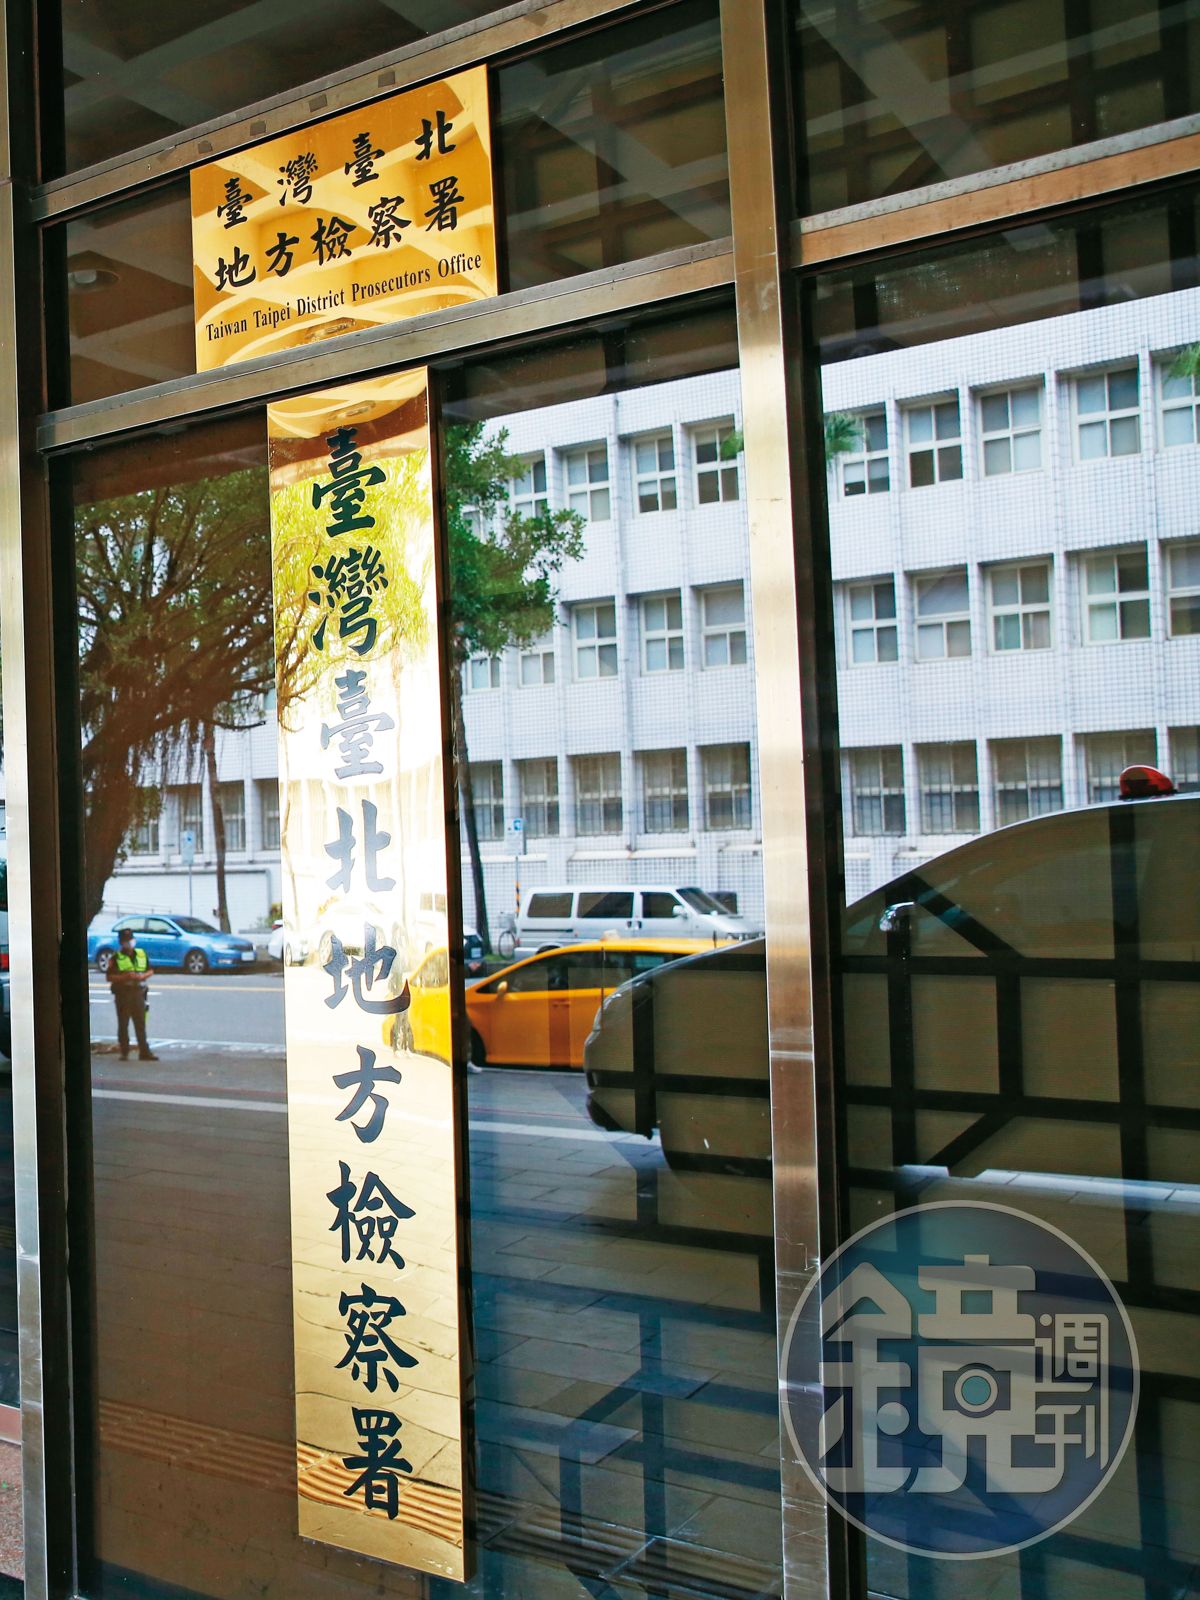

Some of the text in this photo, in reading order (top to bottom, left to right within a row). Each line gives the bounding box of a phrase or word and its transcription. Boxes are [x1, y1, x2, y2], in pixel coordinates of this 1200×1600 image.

[216, 111, 456, 229] 臺灣臺北
[214, 176, 465, 291] 地方檢察署
[206, 253, 482, 341] Taiwan Taipei District Prosecutors Office
[311, 427, 419, 1521] 臺灣臺北地方檢察署
